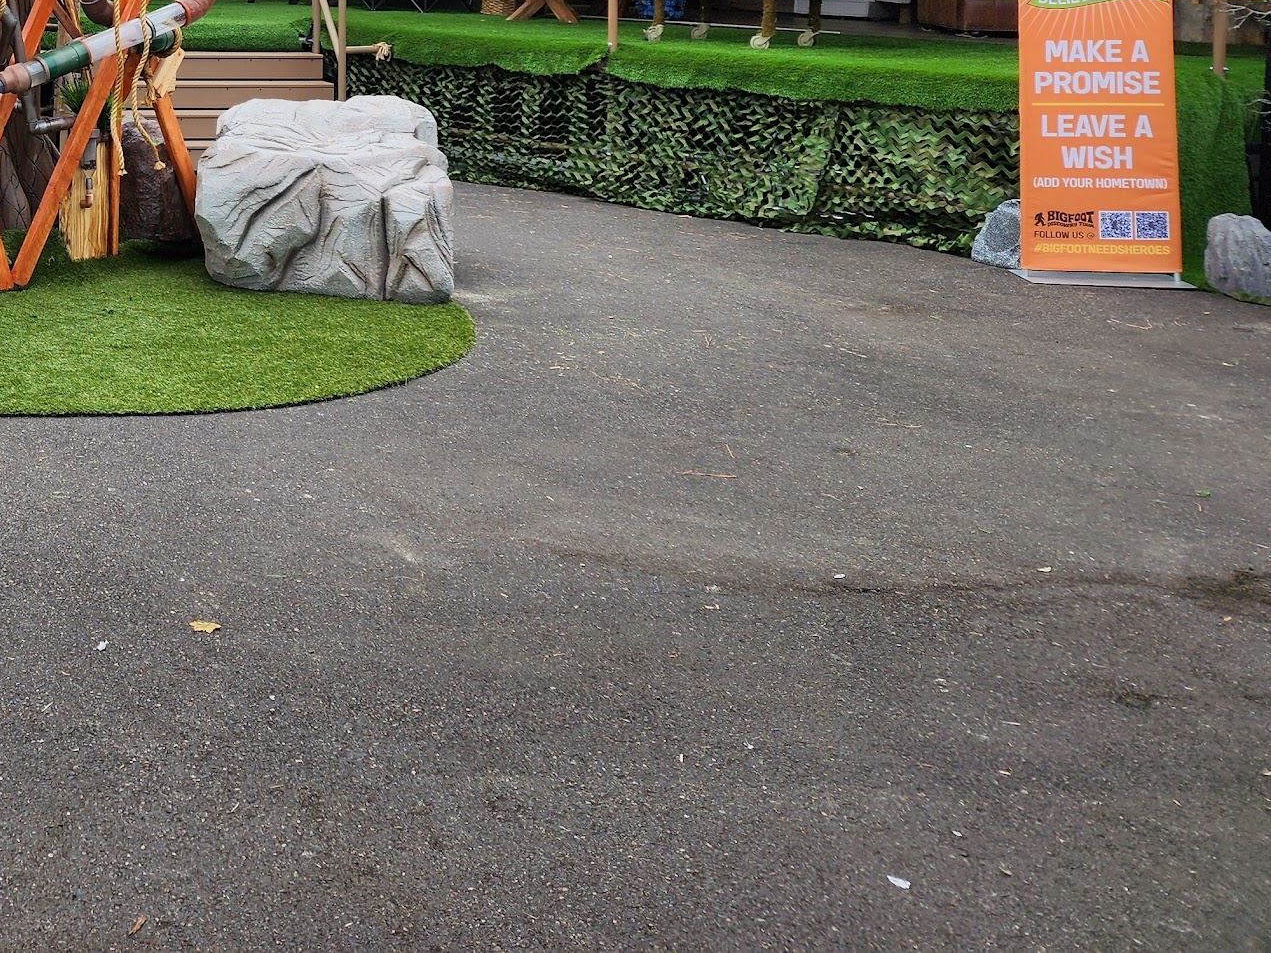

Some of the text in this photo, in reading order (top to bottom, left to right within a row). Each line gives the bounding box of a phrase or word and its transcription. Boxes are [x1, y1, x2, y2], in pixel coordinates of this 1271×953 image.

[1045, 39, 1150, 63] MAKE A
[1034, 71, 1161, 95] PROMISE
[1041, 114, 1153, 137] LEAVE A
[1061, 145, 1133, 169] WISH
[1033, 177, 1168, 190] (ADD YOUR HOMETOWN)
[1047, 210, 1094, 224] BIGFOOT
[1034, 231, 1069, 239] FOLLOW
[1072, 231, 1084, 239] US
[1034, 243, 1170, 255] #BIGFOOTNEEDSHEROES
